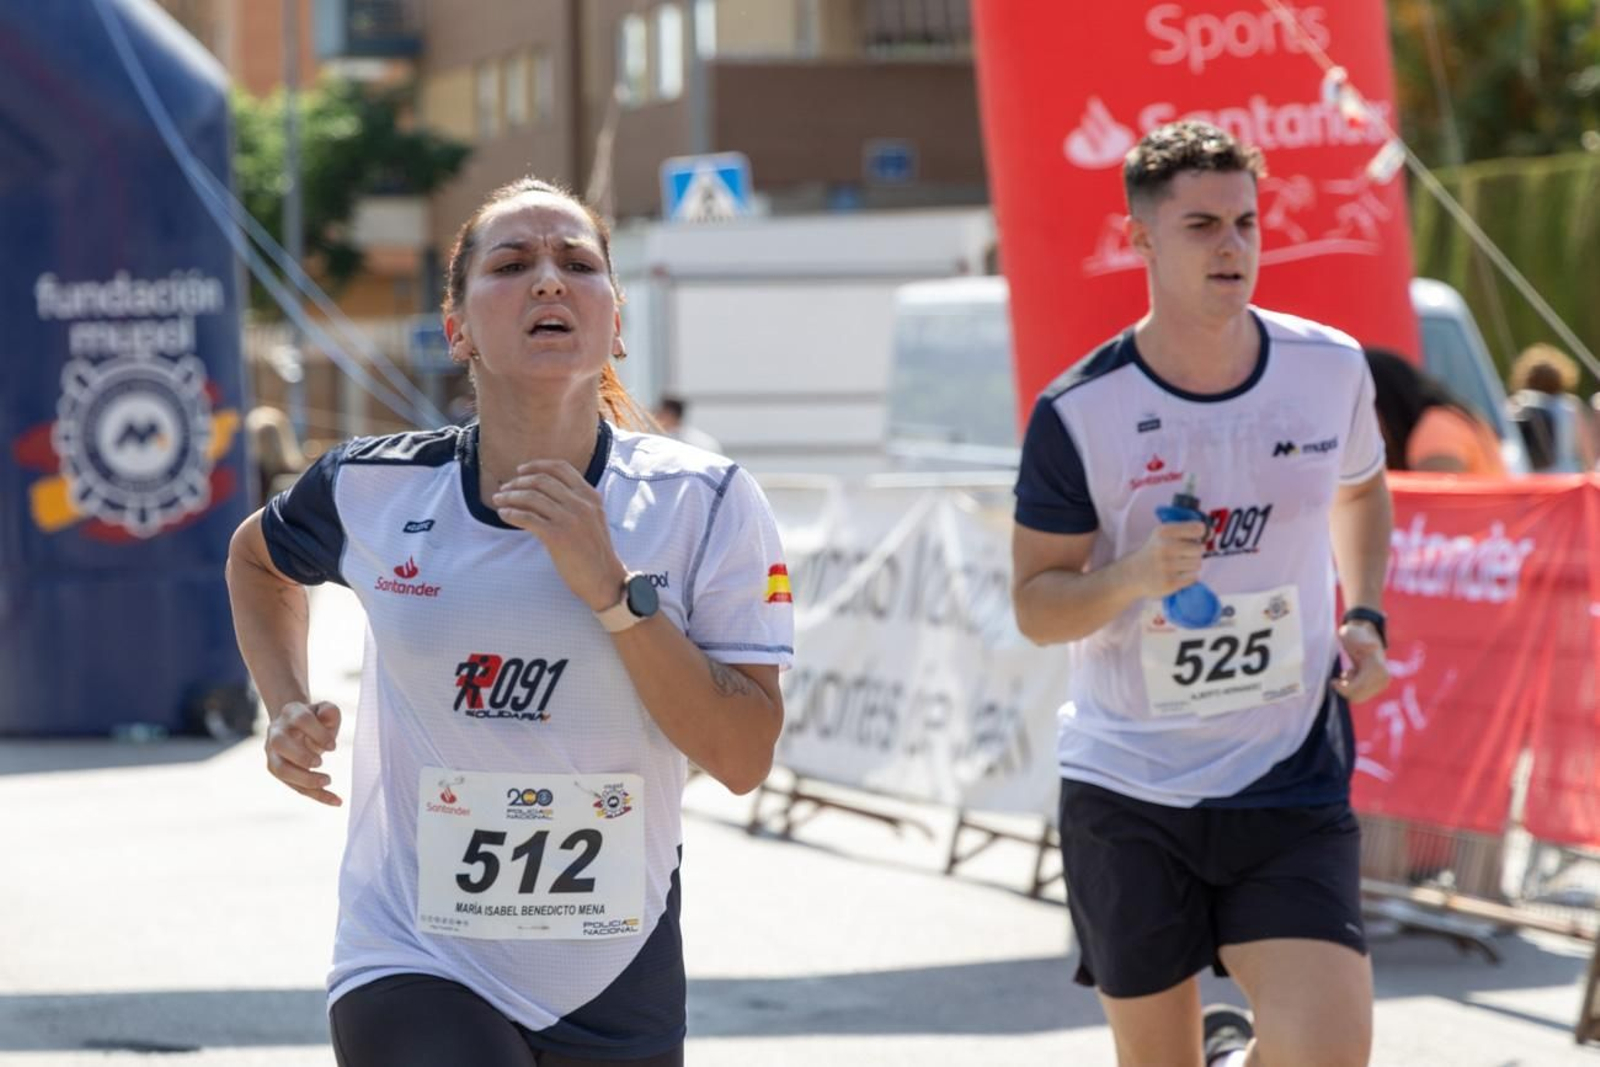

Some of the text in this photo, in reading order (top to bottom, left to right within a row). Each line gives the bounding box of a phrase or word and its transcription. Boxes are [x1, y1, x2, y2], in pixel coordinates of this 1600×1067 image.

[1145, 3, 1331, 75] Sports
[35, 268, 224, 320] fundación
[1129, 471, 1183, 491] Santander
[375, 576, 441, 597] Santander
[1172, 628, 1273, 686] 525
[426, 802, 471, 816] Santander
[455, 828, 603, 894] 512
[455, 902, 605, 917] MARÍA ISABEL BENEDICTO MENA
[583, 926, 638, 936] NACIONAL
